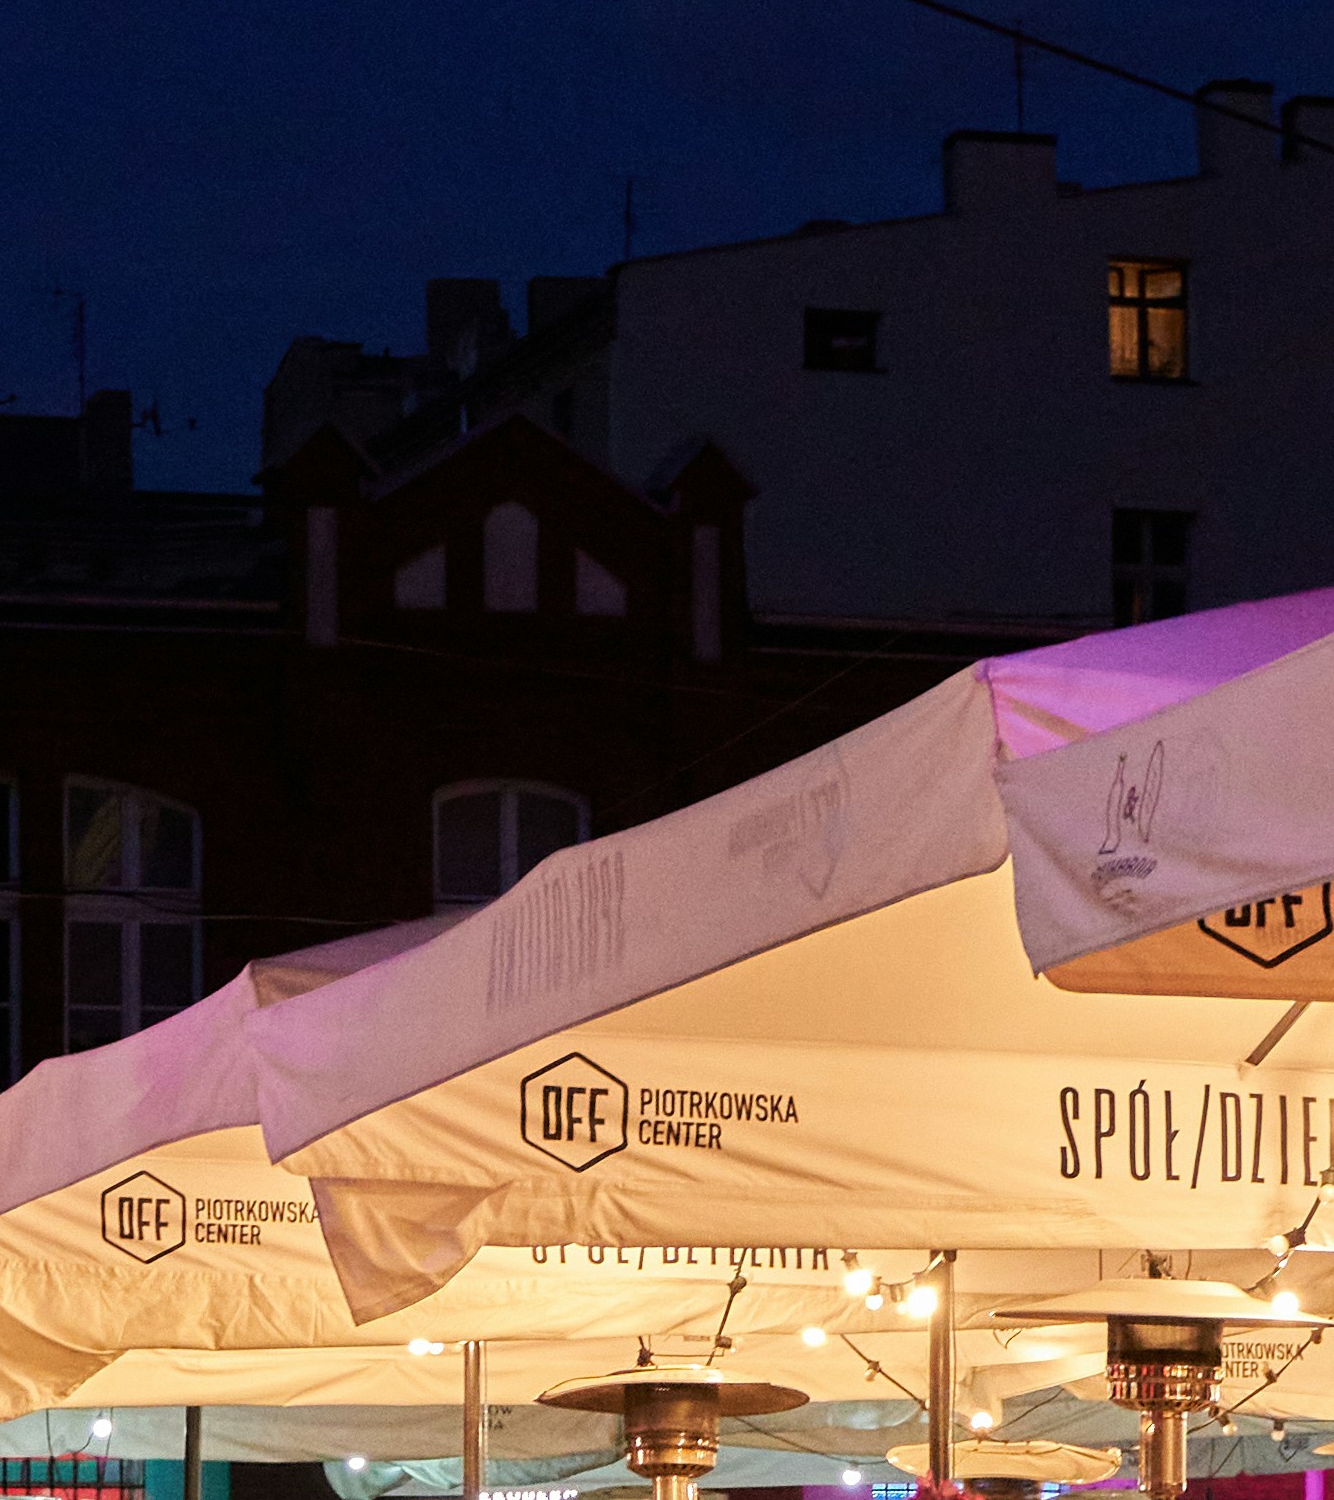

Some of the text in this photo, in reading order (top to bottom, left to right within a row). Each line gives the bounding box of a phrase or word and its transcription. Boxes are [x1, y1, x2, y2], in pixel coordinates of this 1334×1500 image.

[542, 1085, 609, 1143] OFF
[639, 1088, 799, 1123] PIOTRKOWSKA
[638, 1119, 722, 1150] CENTER
[118, 1196, 171, 1241] OFF
[195, 1222, 262, 1246] CENTER
[1222, 1361, 1260, 1378] NTER
